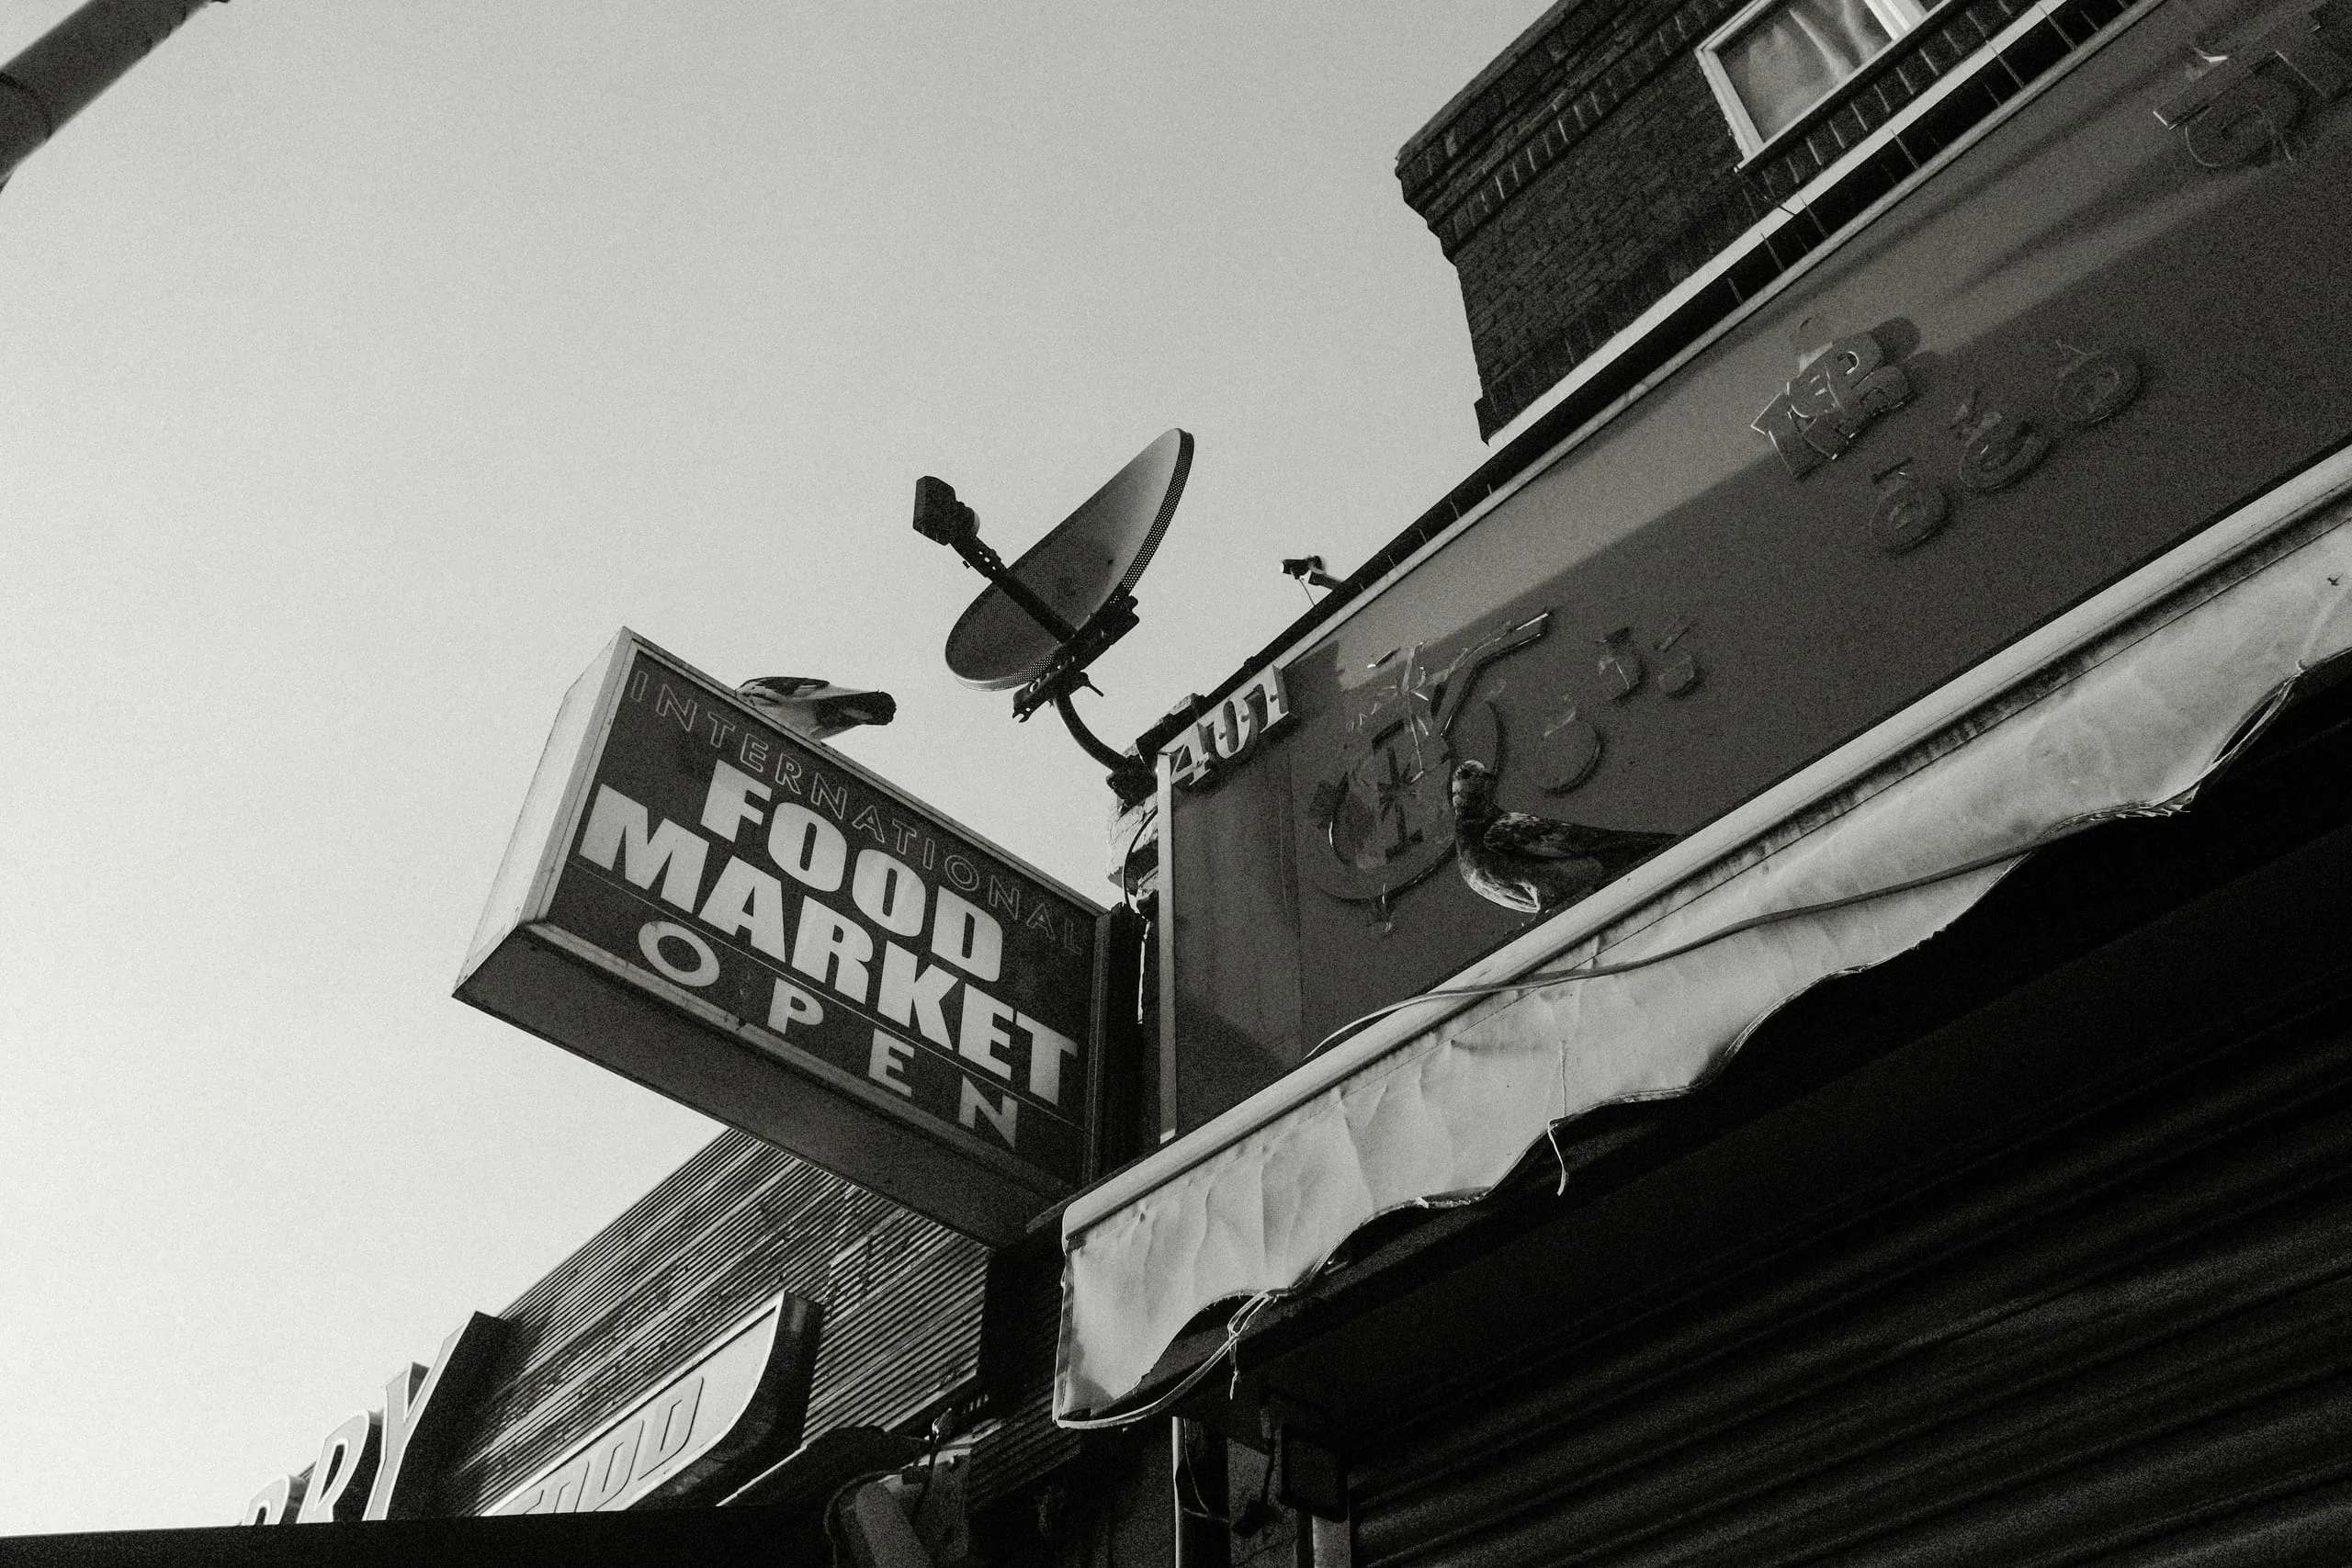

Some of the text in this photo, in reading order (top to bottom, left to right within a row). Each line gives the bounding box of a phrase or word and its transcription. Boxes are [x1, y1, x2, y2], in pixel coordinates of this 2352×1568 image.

[630, 670, 1082, 955] INTERNATIONAL
[1170, 664, 1290, 786] 401
[578, 782, 1080, 1107] MARKET
[699, 758, 1004, 984] FOOD
[638, 919, 1019, 1149] OPEN
[505, 1376, 705, 1515] OOD
